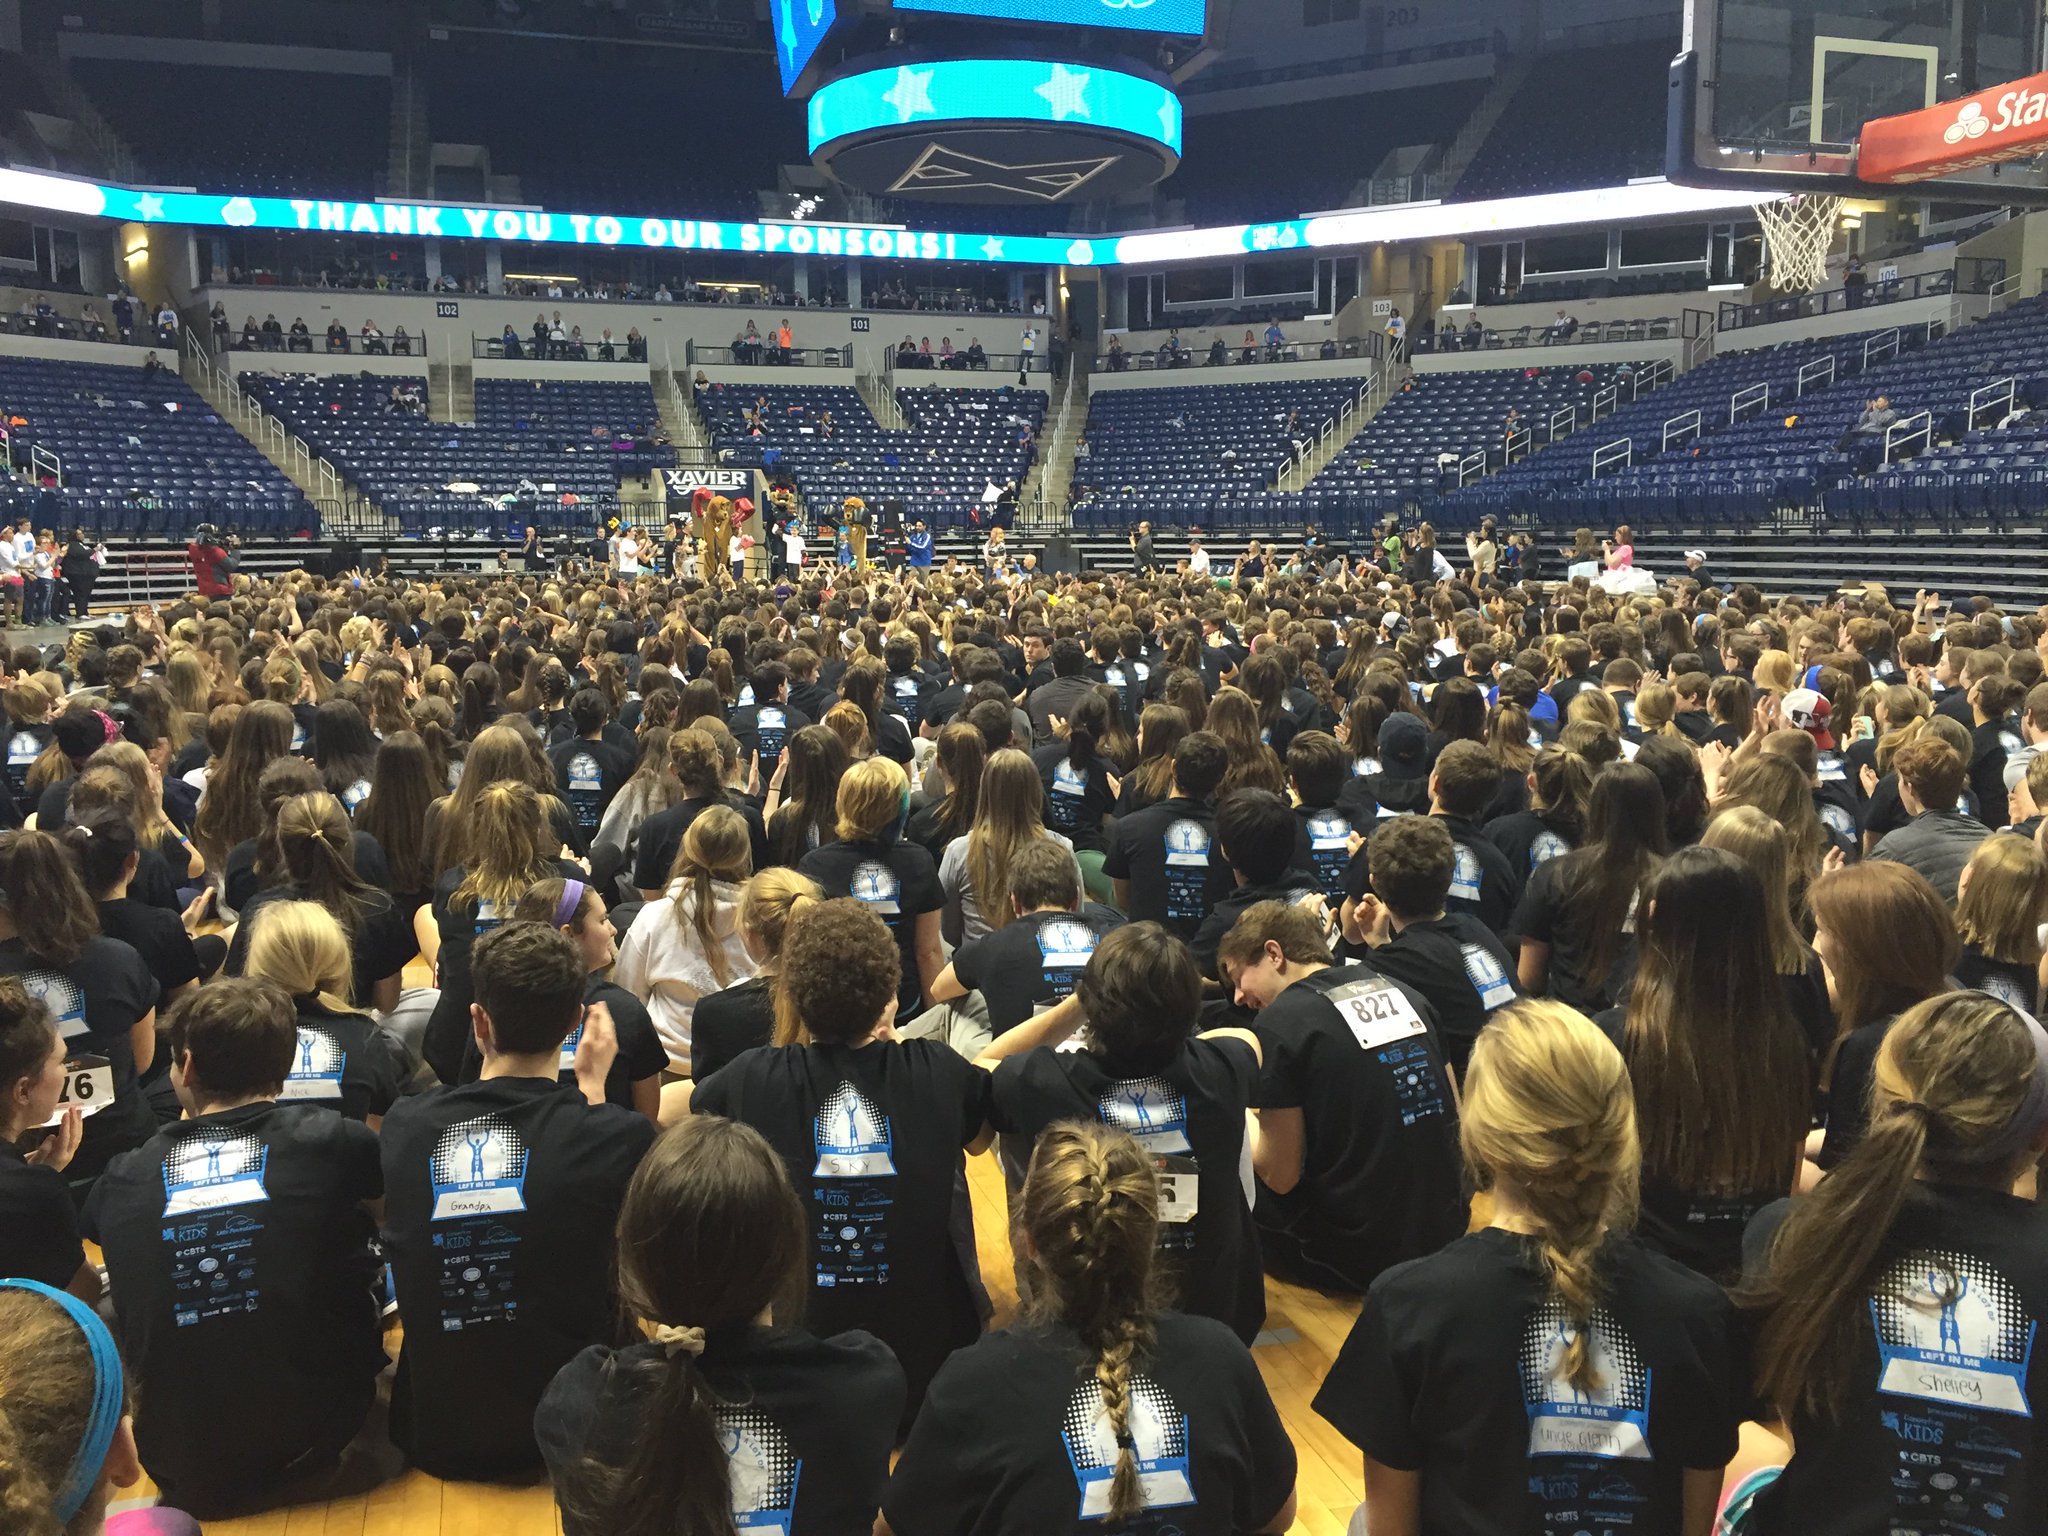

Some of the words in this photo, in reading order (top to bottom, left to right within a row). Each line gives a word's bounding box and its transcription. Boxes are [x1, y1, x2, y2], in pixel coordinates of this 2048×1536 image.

[1387, 6, 1419, 27] 203
[1991, 88, 2048, 132] Sta
[290, 199, 444, 236] THANK
[462, 207, 553, 242] YOU
[569, 213, 624, 245] TO
[641, 217, 723, 250] OUR
[740, 223, 956, 260] SPONSORS!
[438, 305, 457, 315] 102
[1374, 303, 1390, 312] 103
[852, 320, 868, 329] 101
[666, 470, 748, 487] XAVIER
[1351, 993, 1400, 1023] 827
[458, 1182, 474, 1190] LEFT
[451, 1200, 492, 1213] Grandpa
[826, 1195, 849, 1207] KIDS
[830, 1213, 848, 1221] CBTS
[178, 1227, 208, 1242] KIDS
[446, 1236, 472, 1249] KIDS
[183, 1246, 206, 1256] CBTS
[450, 1255, 471, 1264] CBTS
[1920, 1351, 1946, 1362] LEFT
[1949, 1355, 1961, 1365] IN
[1964, 1358, 1981, 1368] ME
[1918, 1373, 1983, 1401] Shelley
[1556, 1404, 1578, 1414] LEFT
[1904, 1422, 1944, 1444] KIDS
[1910, 1452, 1942, 1465] CBTS
[1555, 1511, 1579, 1522] CBTS
